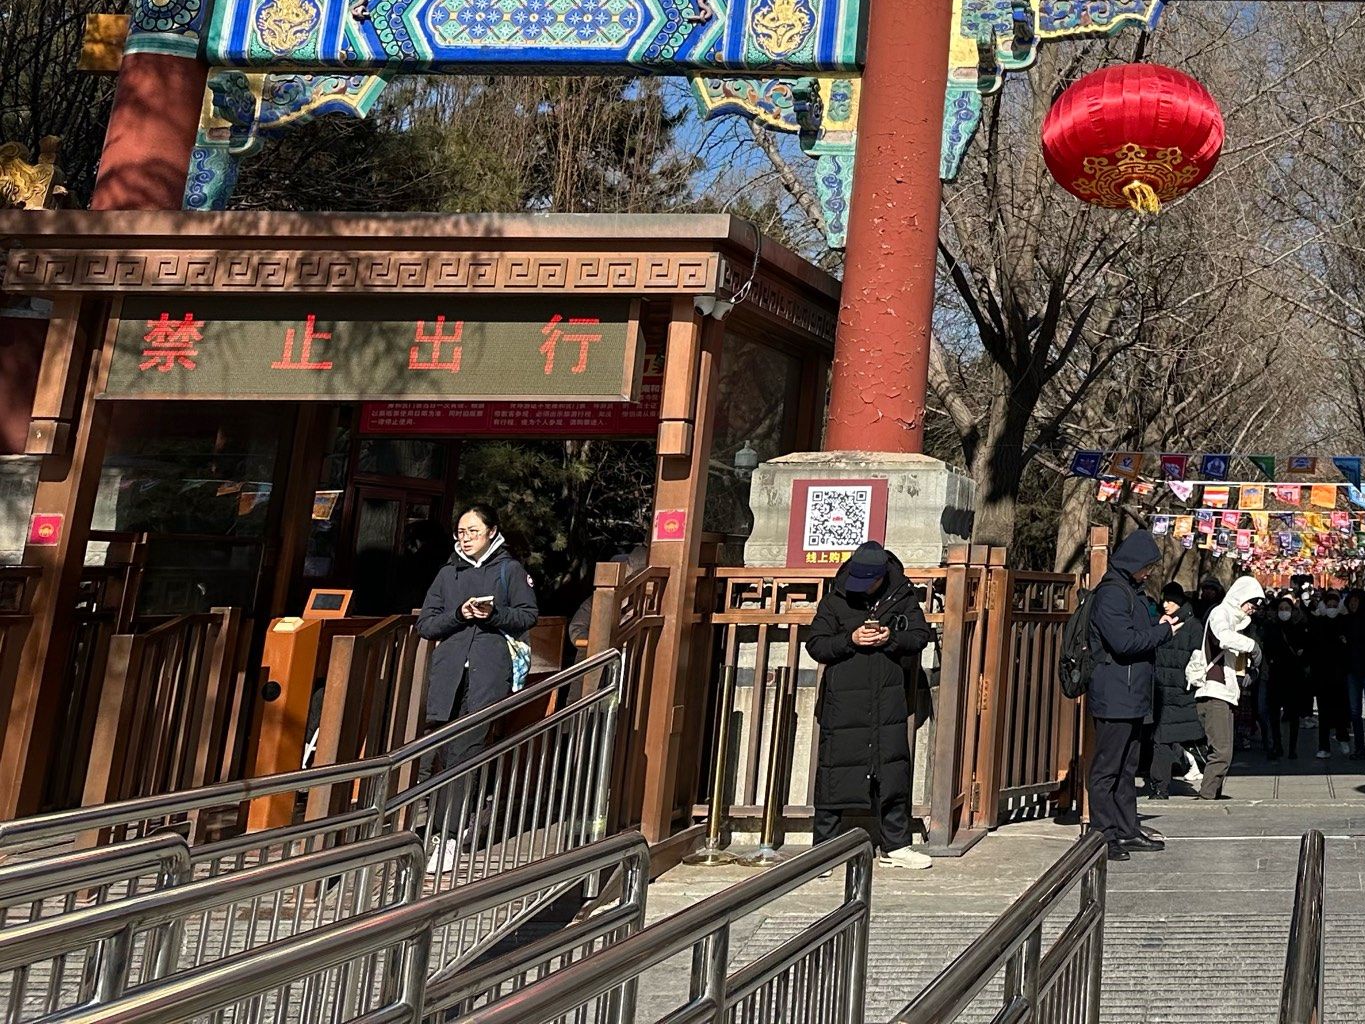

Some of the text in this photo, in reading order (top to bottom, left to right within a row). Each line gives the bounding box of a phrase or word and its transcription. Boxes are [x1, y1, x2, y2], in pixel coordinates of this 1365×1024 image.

[139, 313, 603, 375] 禁止出行
[806, 552, 852, 563] 线上购票
